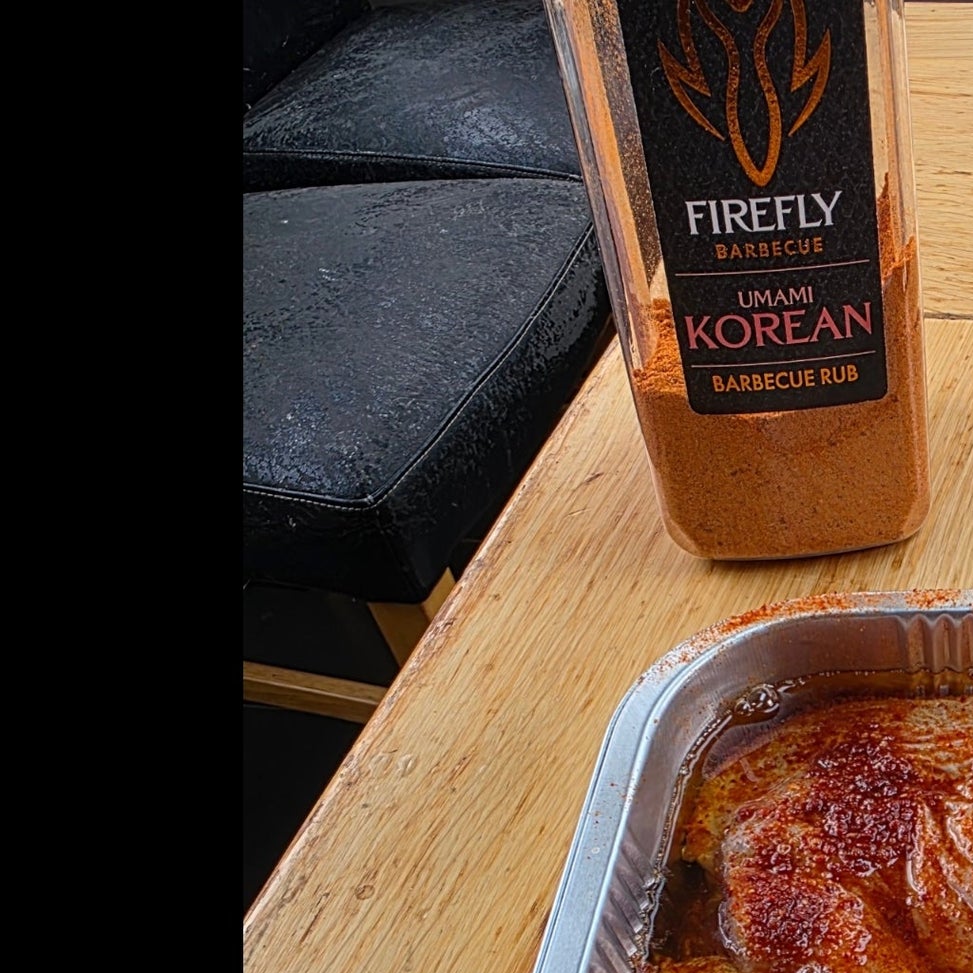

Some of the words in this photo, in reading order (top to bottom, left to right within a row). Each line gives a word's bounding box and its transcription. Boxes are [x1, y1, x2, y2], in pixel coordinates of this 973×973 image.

[685, 190, 843, 235] FIREFLY
[715, 236, 823, 260] BARBECUE
[737, 286, 814, 308] UMAMI
[684, 301, 872, 350] KOREAN
[712, 368, 815, 393] BARBECUE
[821, 364, 859, 385] RUB
